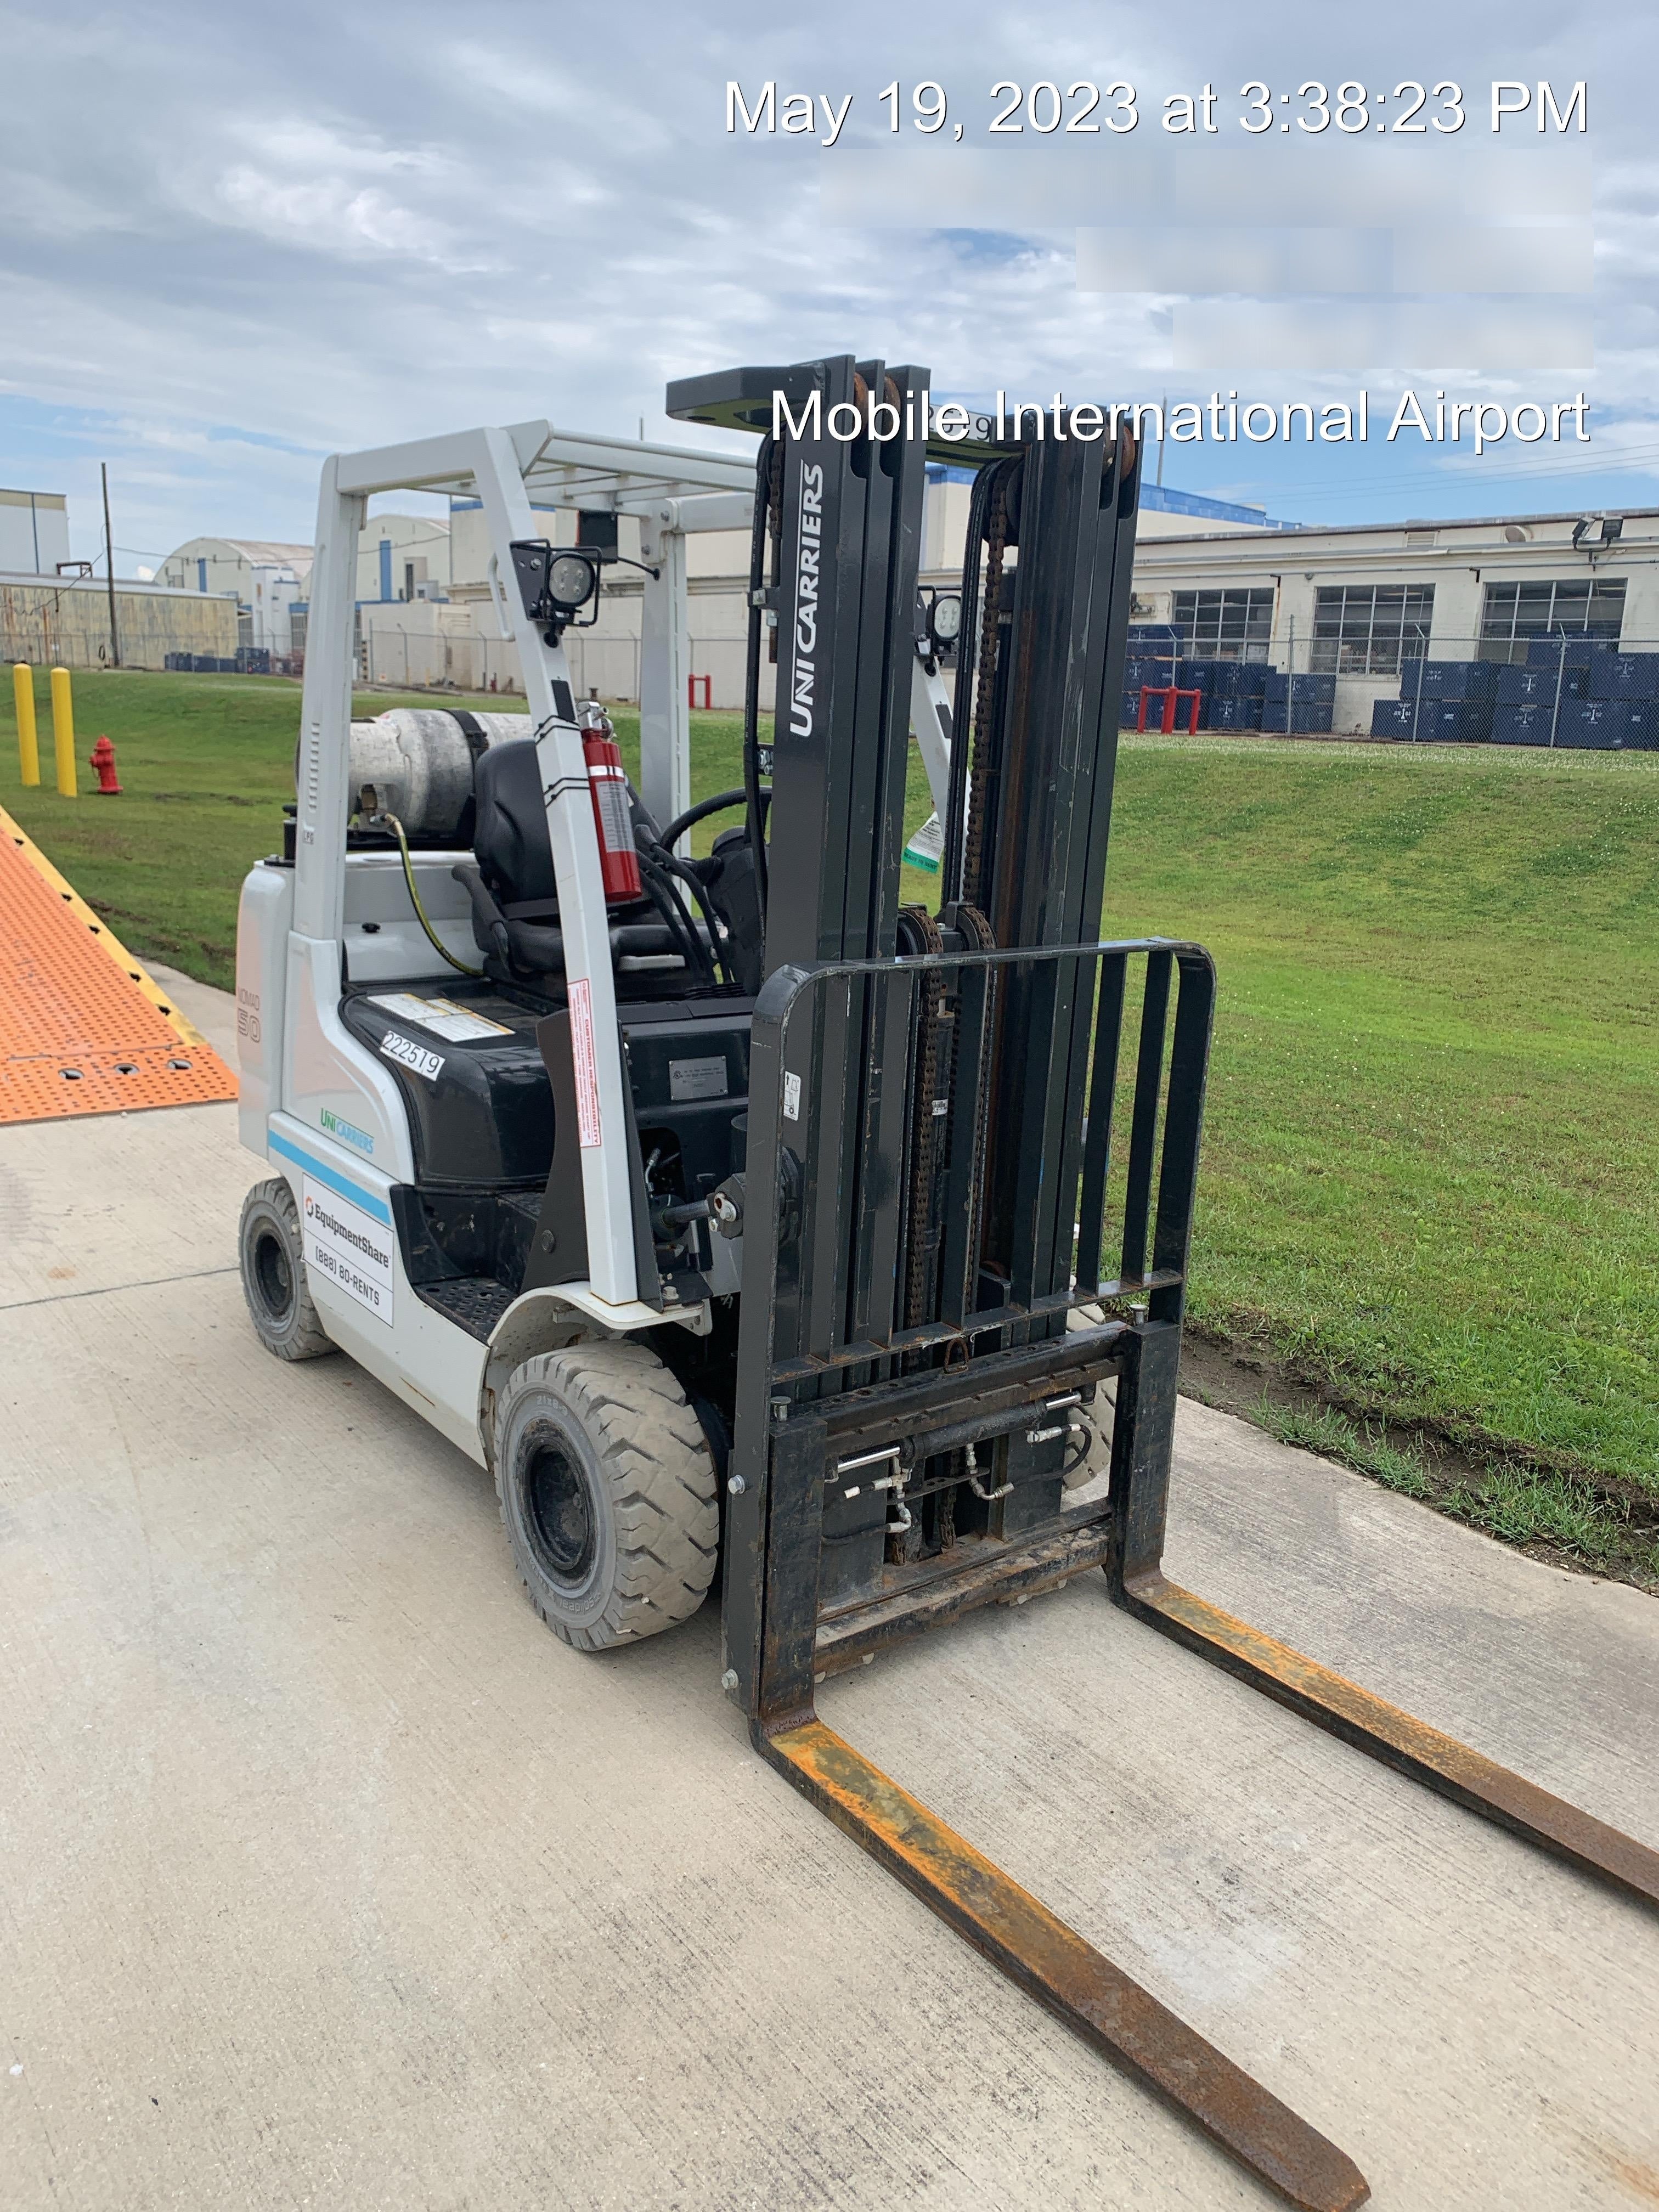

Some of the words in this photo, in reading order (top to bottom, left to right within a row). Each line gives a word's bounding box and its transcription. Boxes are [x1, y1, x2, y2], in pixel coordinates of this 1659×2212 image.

[238, 1007, 261, 1043] 50
[383, 1031, 440, 1074] 222519
[315, 1203, 390, 1269] EquipmentShare
[315, 1245, 337, 1275] (888)
[339, 1265, 380, 1306] 80-RENTS
